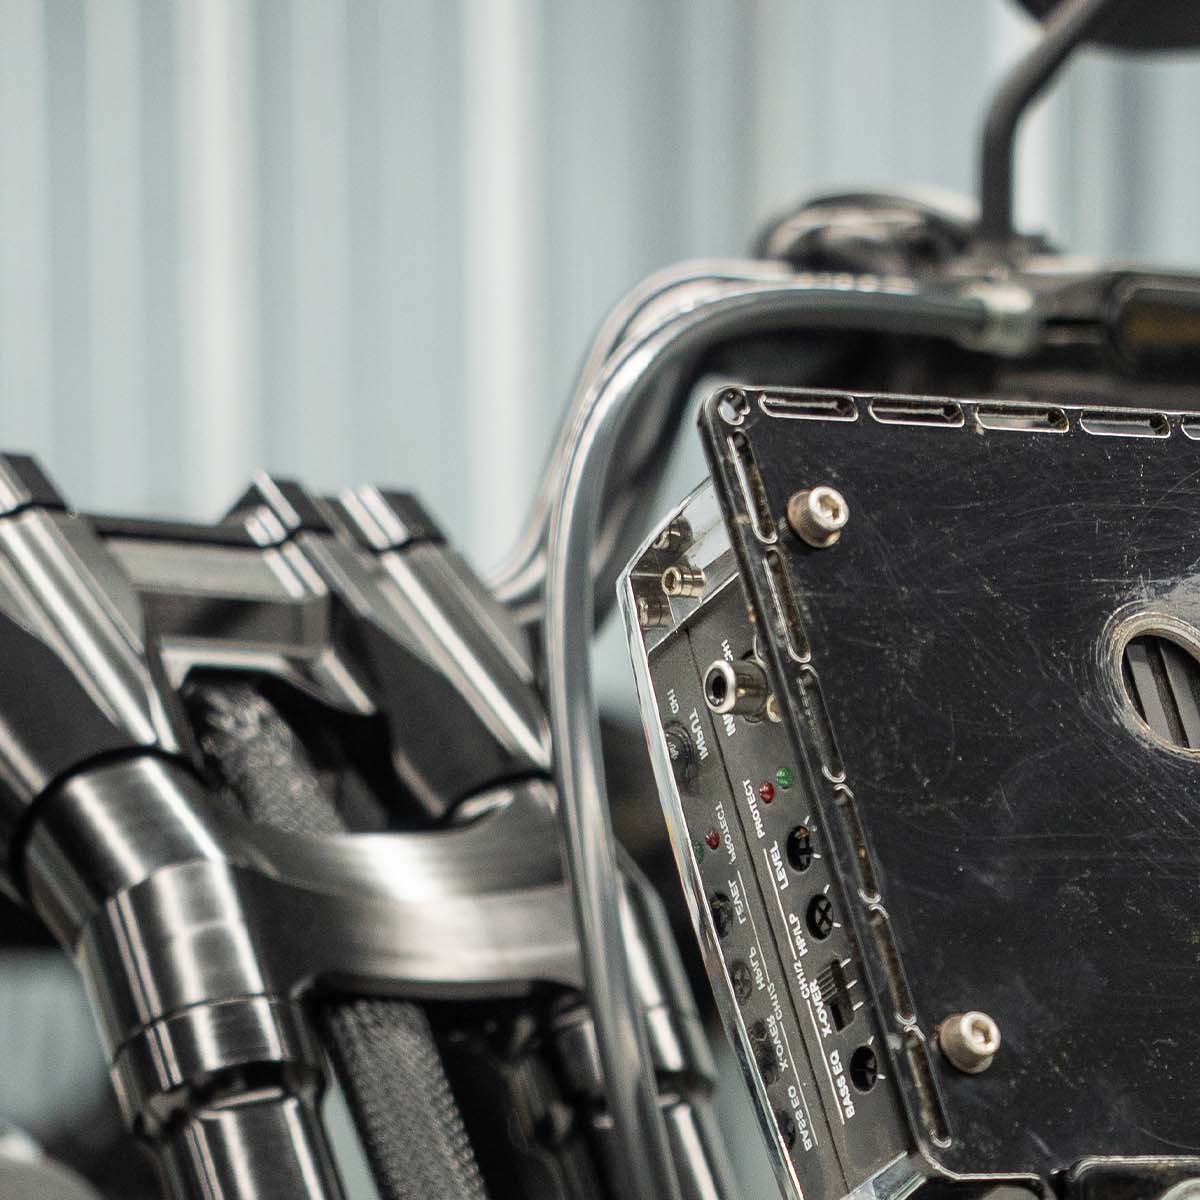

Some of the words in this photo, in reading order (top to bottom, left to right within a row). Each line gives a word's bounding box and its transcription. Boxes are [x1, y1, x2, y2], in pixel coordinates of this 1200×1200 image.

[743, 779, 765, 839] PROTECT
[770, 840, 789, 890] LEVEL
[789, 913, 808, 957] HP/LP
[809, 979, 832, 1038] X-OVER
[829, 1050, 844, 1075] EQ
[837, 1076, 855, 1119] BASS
